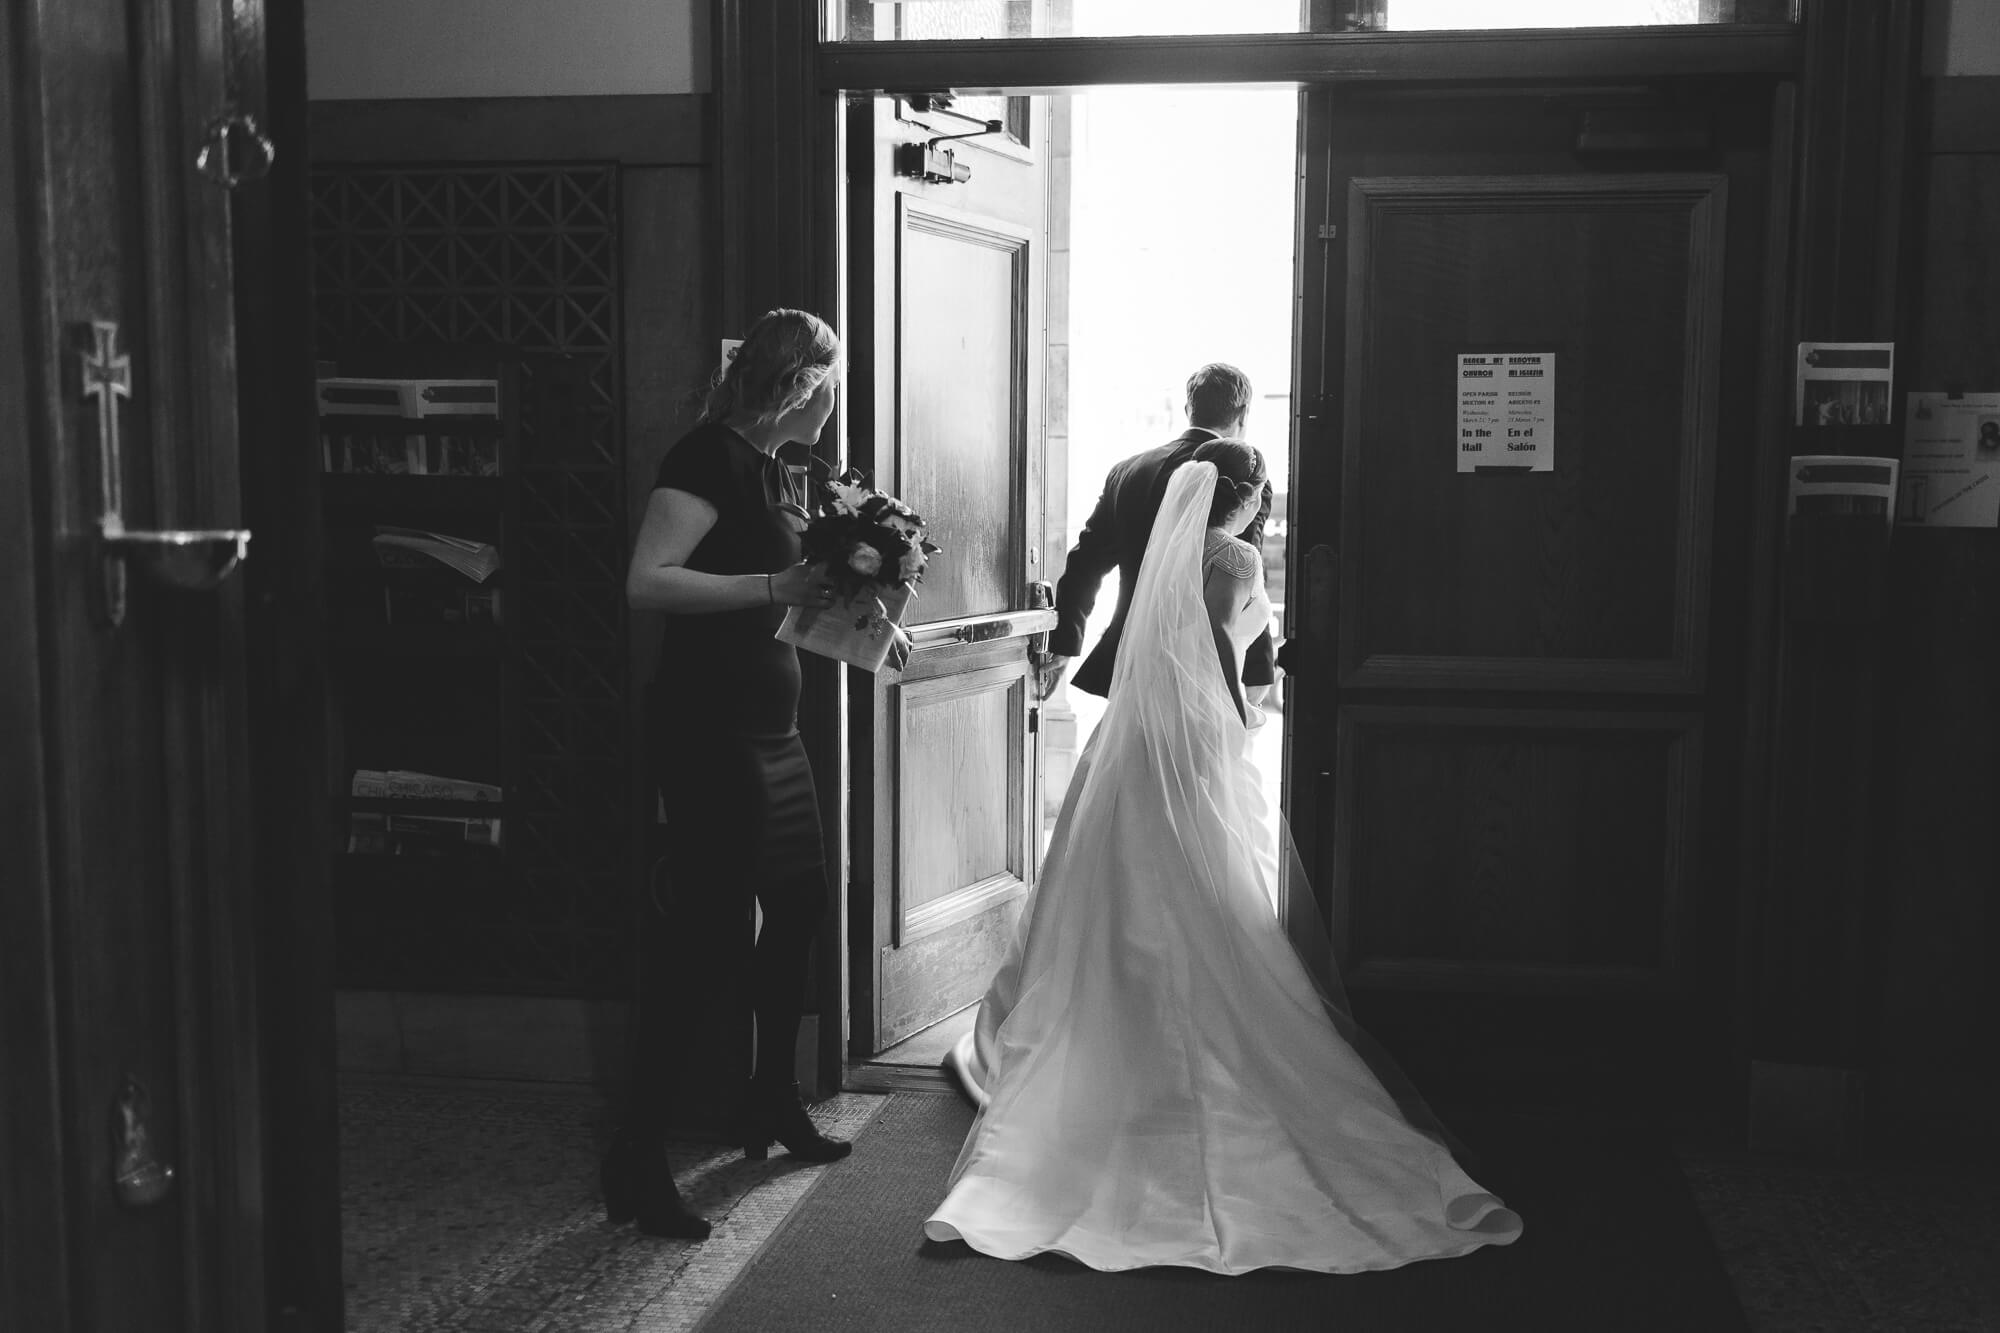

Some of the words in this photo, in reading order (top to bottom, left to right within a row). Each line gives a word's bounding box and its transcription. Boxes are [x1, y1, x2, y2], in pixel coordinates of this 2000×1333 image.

[1462, 428, 1473, 437] In
[1475, 428, 1492, 437] the
[1507, 427, 1521, 437] En
[1523, 427, 1533, 437] el
[1462, 442, 1482, 452] Hall
[1507, 441, 1536, 452] Salón
[389, 782, 453, 796] CHICAGO
